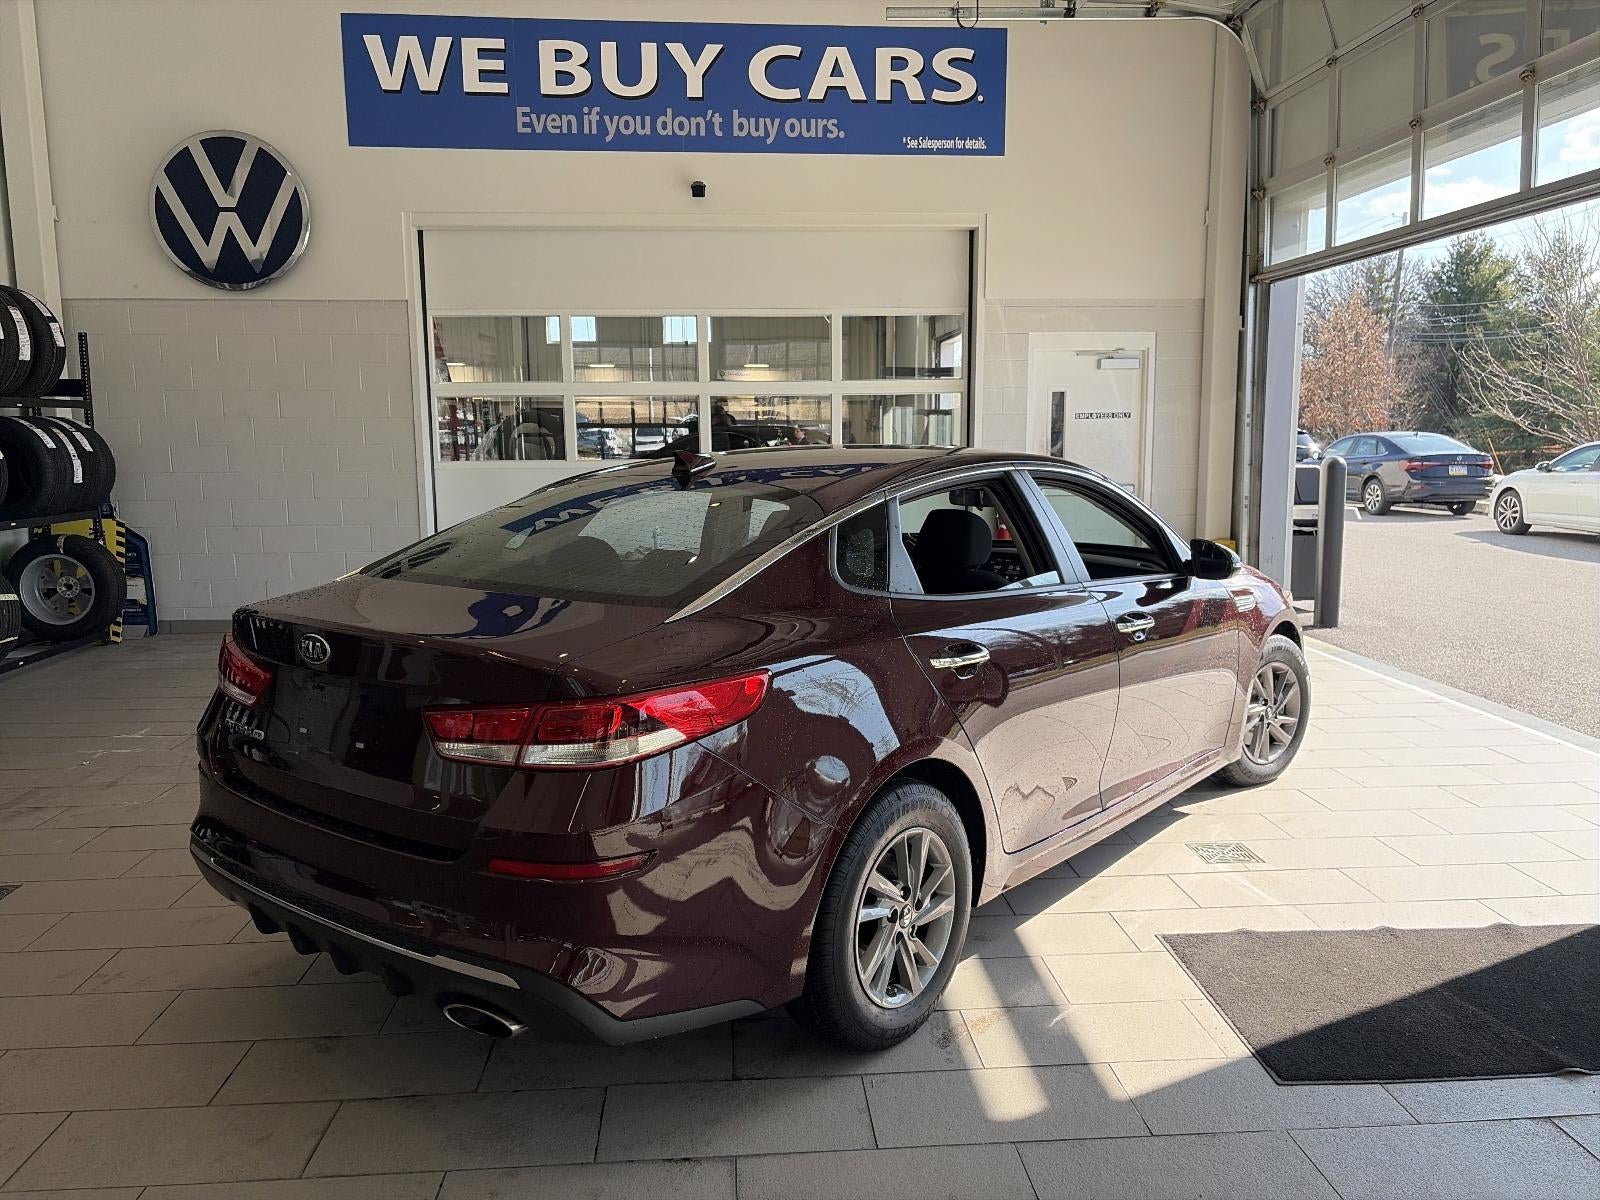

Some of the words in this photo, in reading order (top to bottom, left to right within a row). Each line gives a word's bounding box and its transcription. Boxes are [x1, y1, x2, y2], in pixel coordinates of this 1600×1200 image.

[362, 34, 510, 96] WE
[538, 38, 726, 100] BUY
[748, 44, 985, 106] CARS.
[516, 106, 578, 134] Even
[582, 106, 600, 135] if
[603, 114, 651, 143] you
[656, 107, 723, 137] don’t
[732, 109, 781, 145] buy
[784, 117, 846, 139] ours.
[918, 136, 955, 151] Salesperson
[955, 136, 965, 149] for
[965, 136, 987, 150] details.
[1074, 412, 1112, 420] EMPLOYEES
[301, 638, 326, 660] KIA
